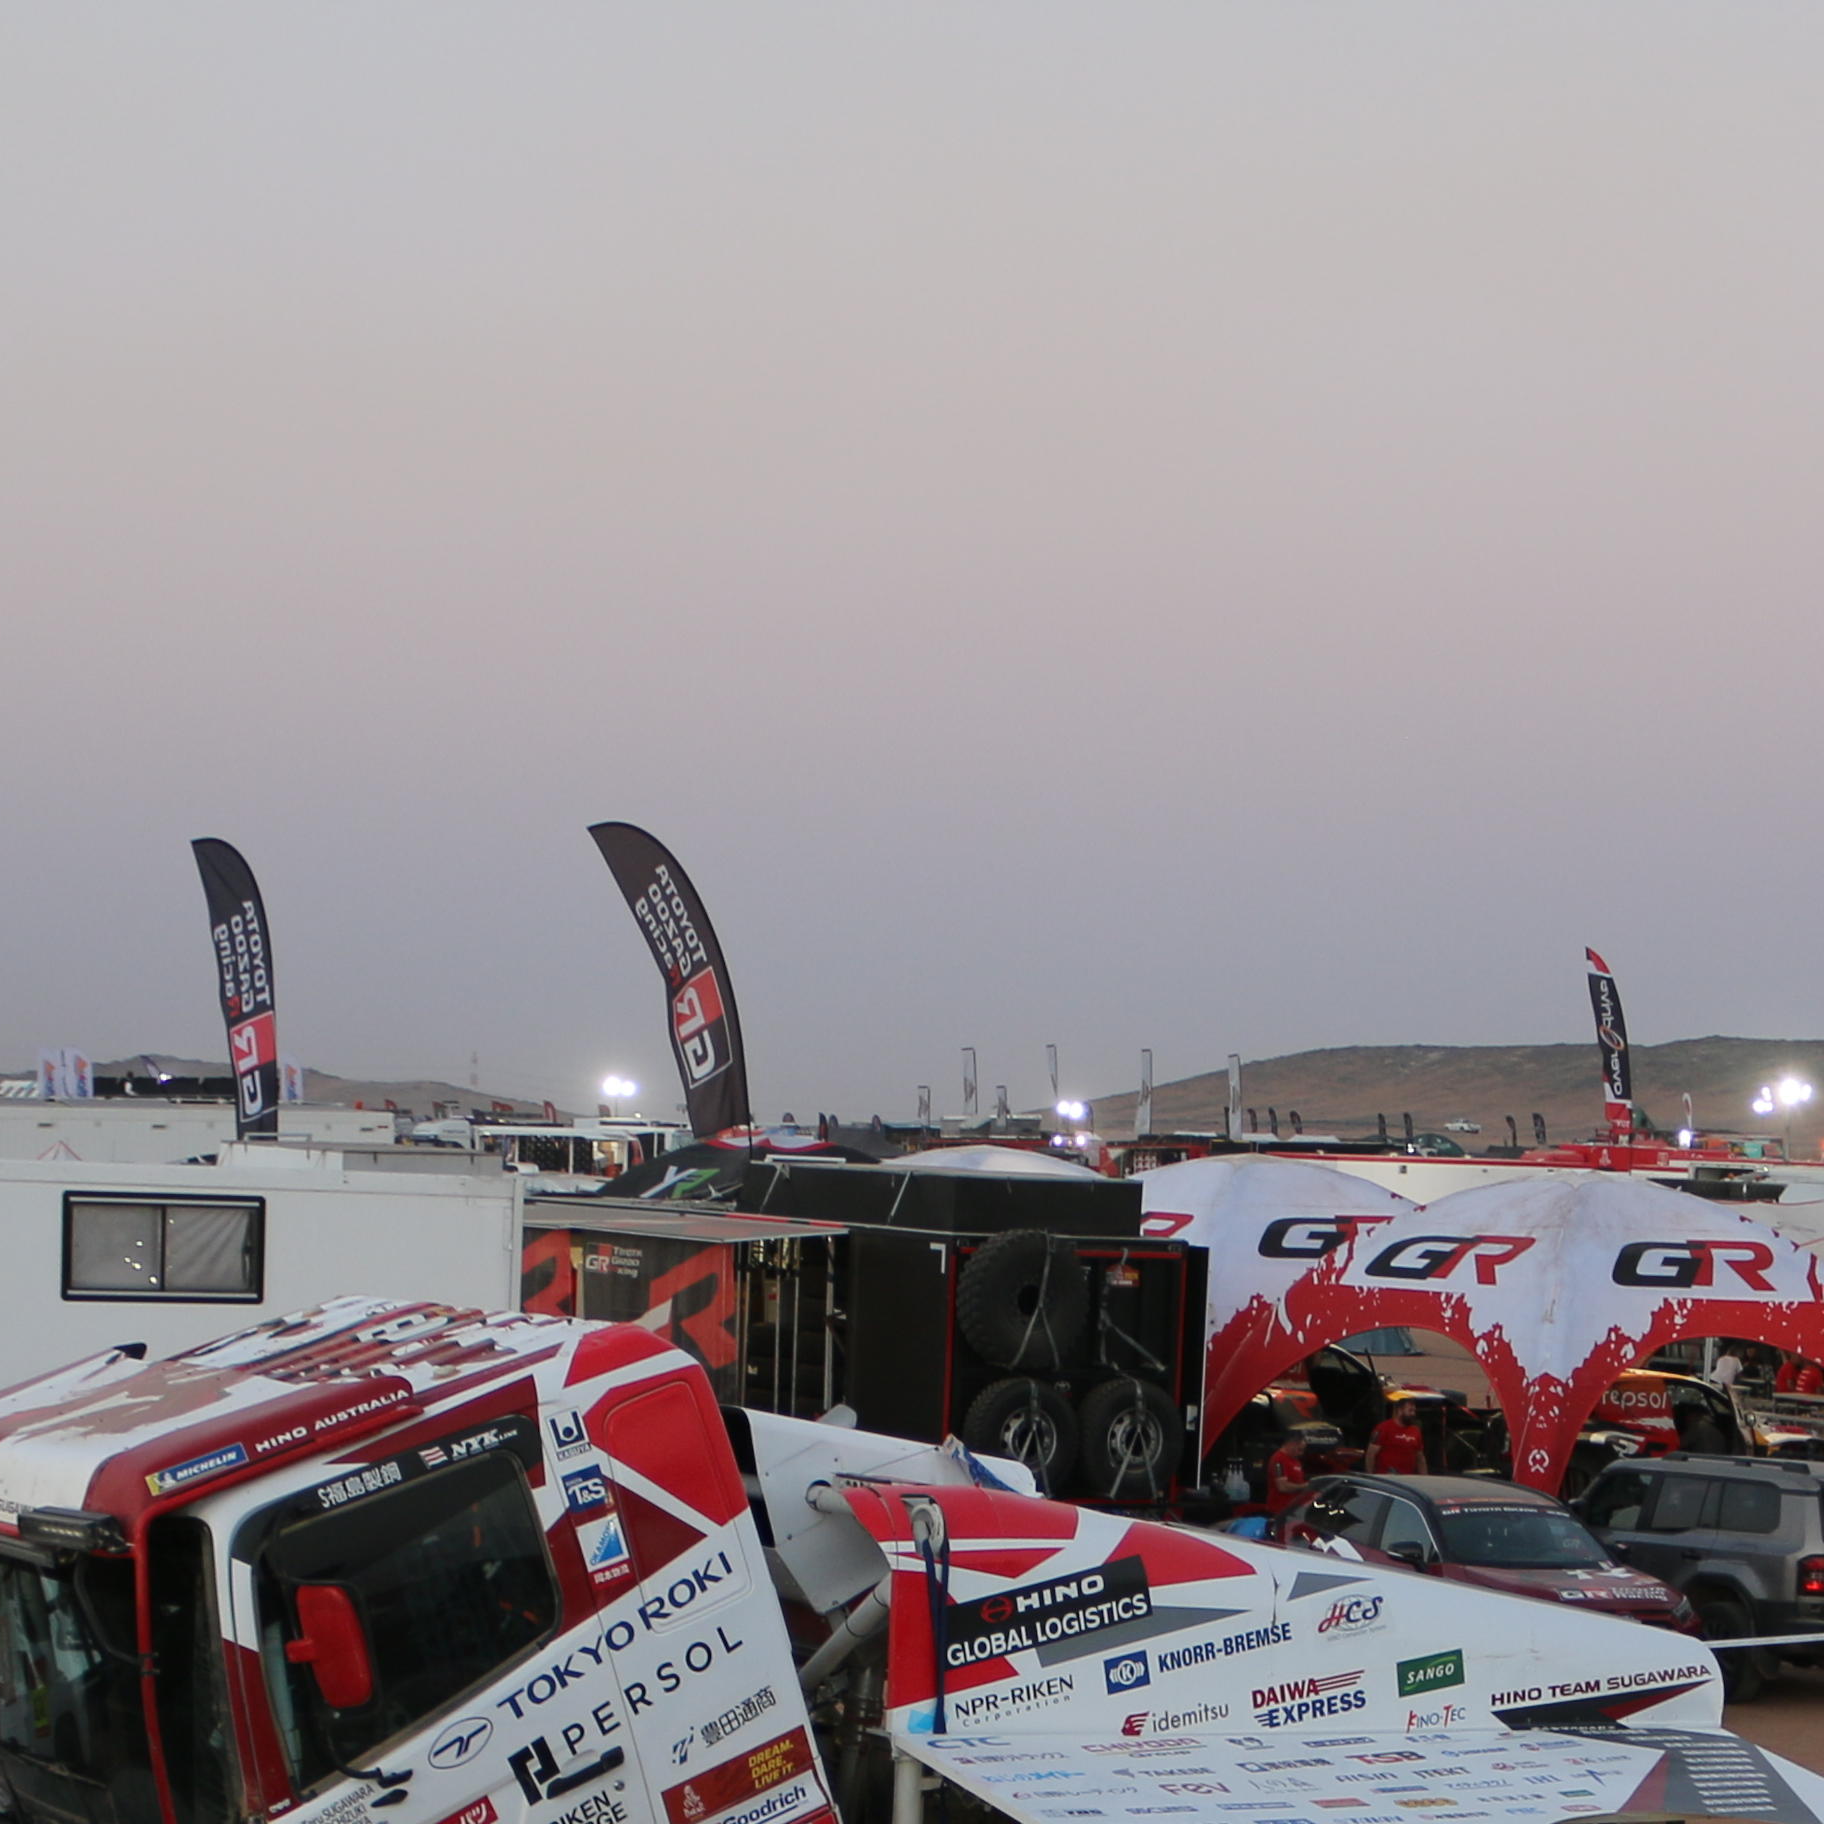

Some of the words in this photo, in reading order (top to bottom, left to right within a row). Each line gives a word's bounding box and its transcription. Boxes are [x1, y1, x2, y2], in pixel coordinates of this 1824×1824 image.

[584, 1254, 610, 1273] GR
[1365, 1235, 1536, 1286] GR
[1612, 1240, 1778, 1291] GR
[1600, 1388, 1670, 1409] repsol
[255, 1427, 308, 1454] HINO
[314, 1388, 409, 1430] AUSTRALIA
[451, 1429, 501, 1457] NYK
[176, 1450, 238, 1481] MICHELIN
[567, 1477, 607, 1505] T&S
[1016, 1573, 1106, 1613] HINO
[946, 1624, 1033, 1667] GLOBAL
[1036, 1593, 1149, 1643] LOGISTICS
[1317, 1596, 1384, 1634] HCS
[496, 1620, 636, 1721] TOKYO
[637, 1551, 734, 1631] ROKI
[1158, 1622, 1294, 1674] KNORR-BREMSE
[1406, 1660, 1455, 1685] SANGO
[1490, 1686, 1543, 1707] HINO
[1547, 1679, 1601, 1699] TEAM
[1606, 1664, 1712, 1690] SUGAWARA
[562, 1626, 744, 1757] PERSOL
[954, 1673, 1074, 1721] NPR-RIKEN
[1252, 1677, 1322, 1709] DAIWA
[962, 1694, 1072, 1728] Corporation
[1151, 1702, 1230, 1733] idemitsu
[1269, 1689, 1367, 1728] EXPRESS
[1407, 1703, 1467, 1733] KINO-TEC
[748, 1738, 794, 1769] DREAM.
[926, 1735, 1012, 1750] CTC
[751, 1757, 787, 1779] DARE.
[755, 1771, 780, 1790] LIVE
[1412, 1766, 1473, 1780] JTEKT
[324, 1783, 376, 1822] SUGAWARA
